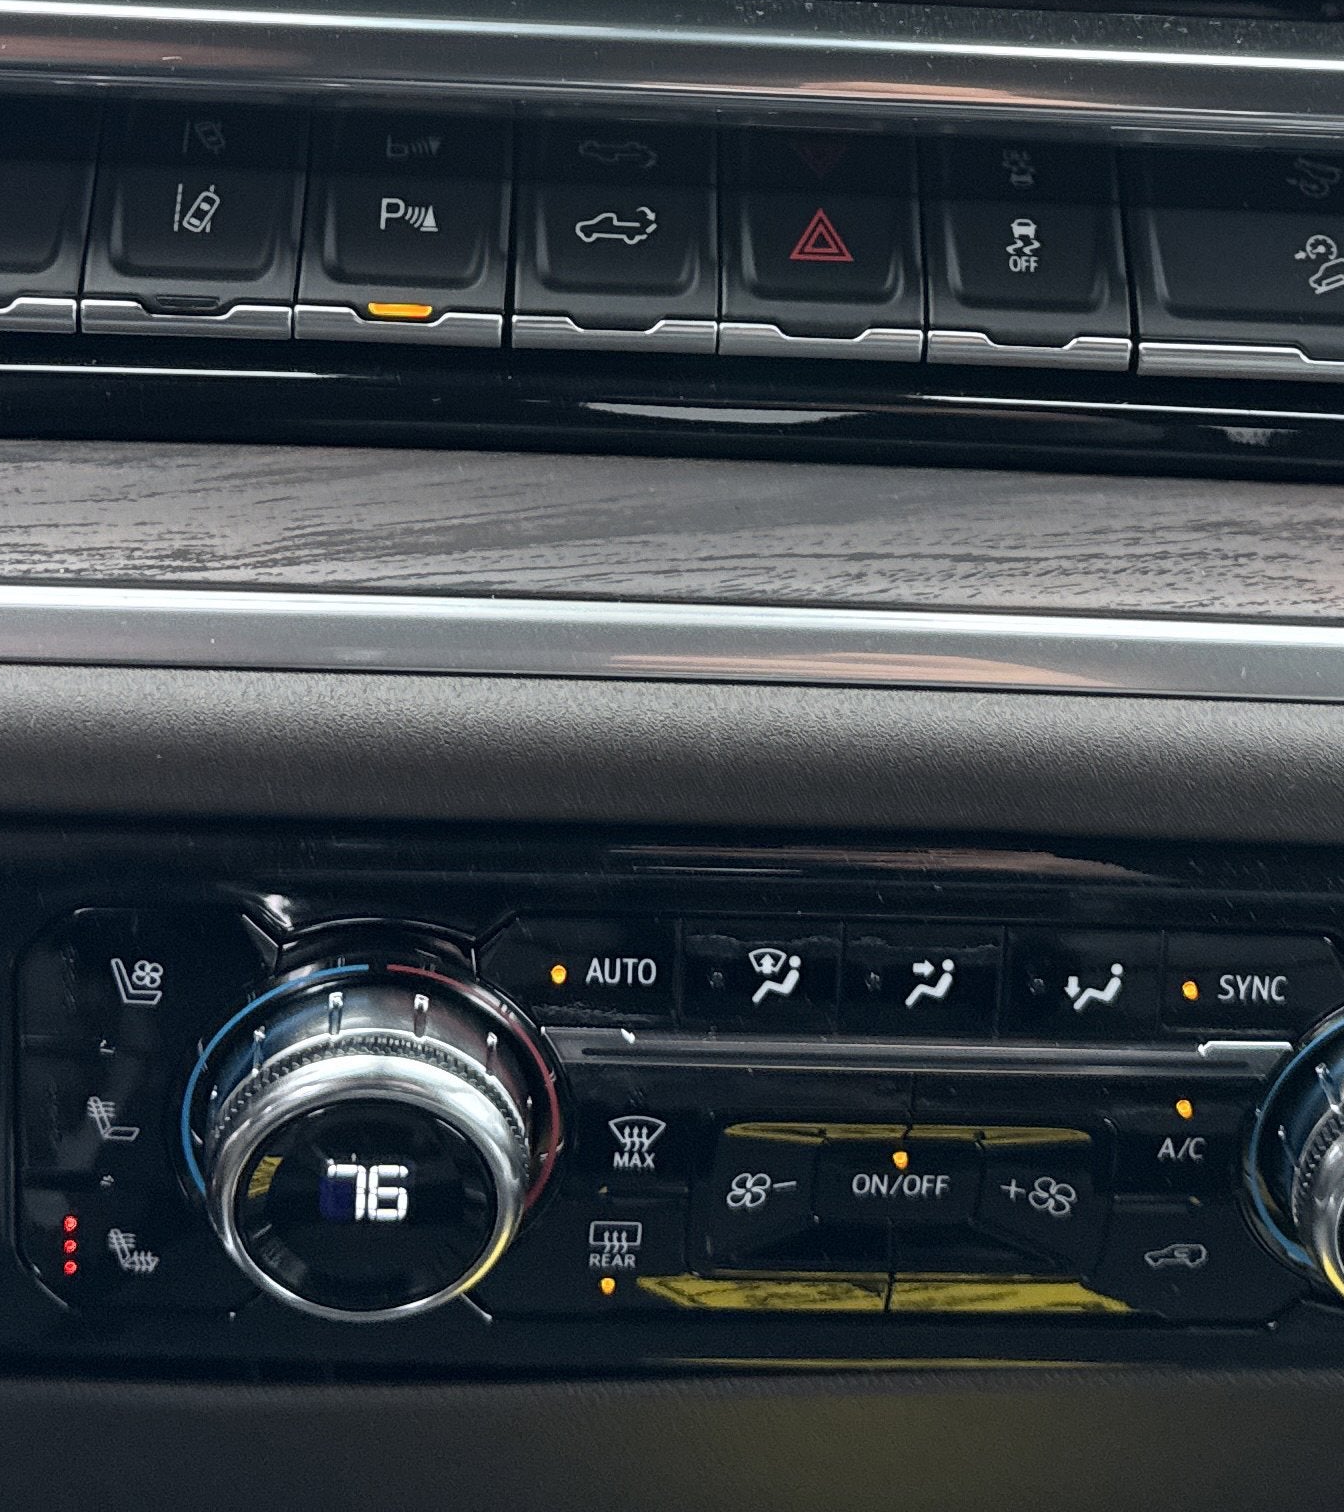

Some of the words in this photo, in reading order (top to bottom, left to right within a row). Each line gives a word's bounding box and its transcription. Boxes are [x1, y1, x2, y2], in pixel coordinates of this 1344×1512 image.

[1008, 255, 1039, 273] OFF
[584, 956, 657, 985] AUTO
[1217, 973, 1288, 1002] SYNC
[613, 1151, 656, 1169] MAX
[1157, 1136, 1206, 1160] A/C
[327, 1163, 409, 1222] 76
[852, 1172, 951, 1196] ON/OFF
[588, 1252, 637, 1269] REAR
